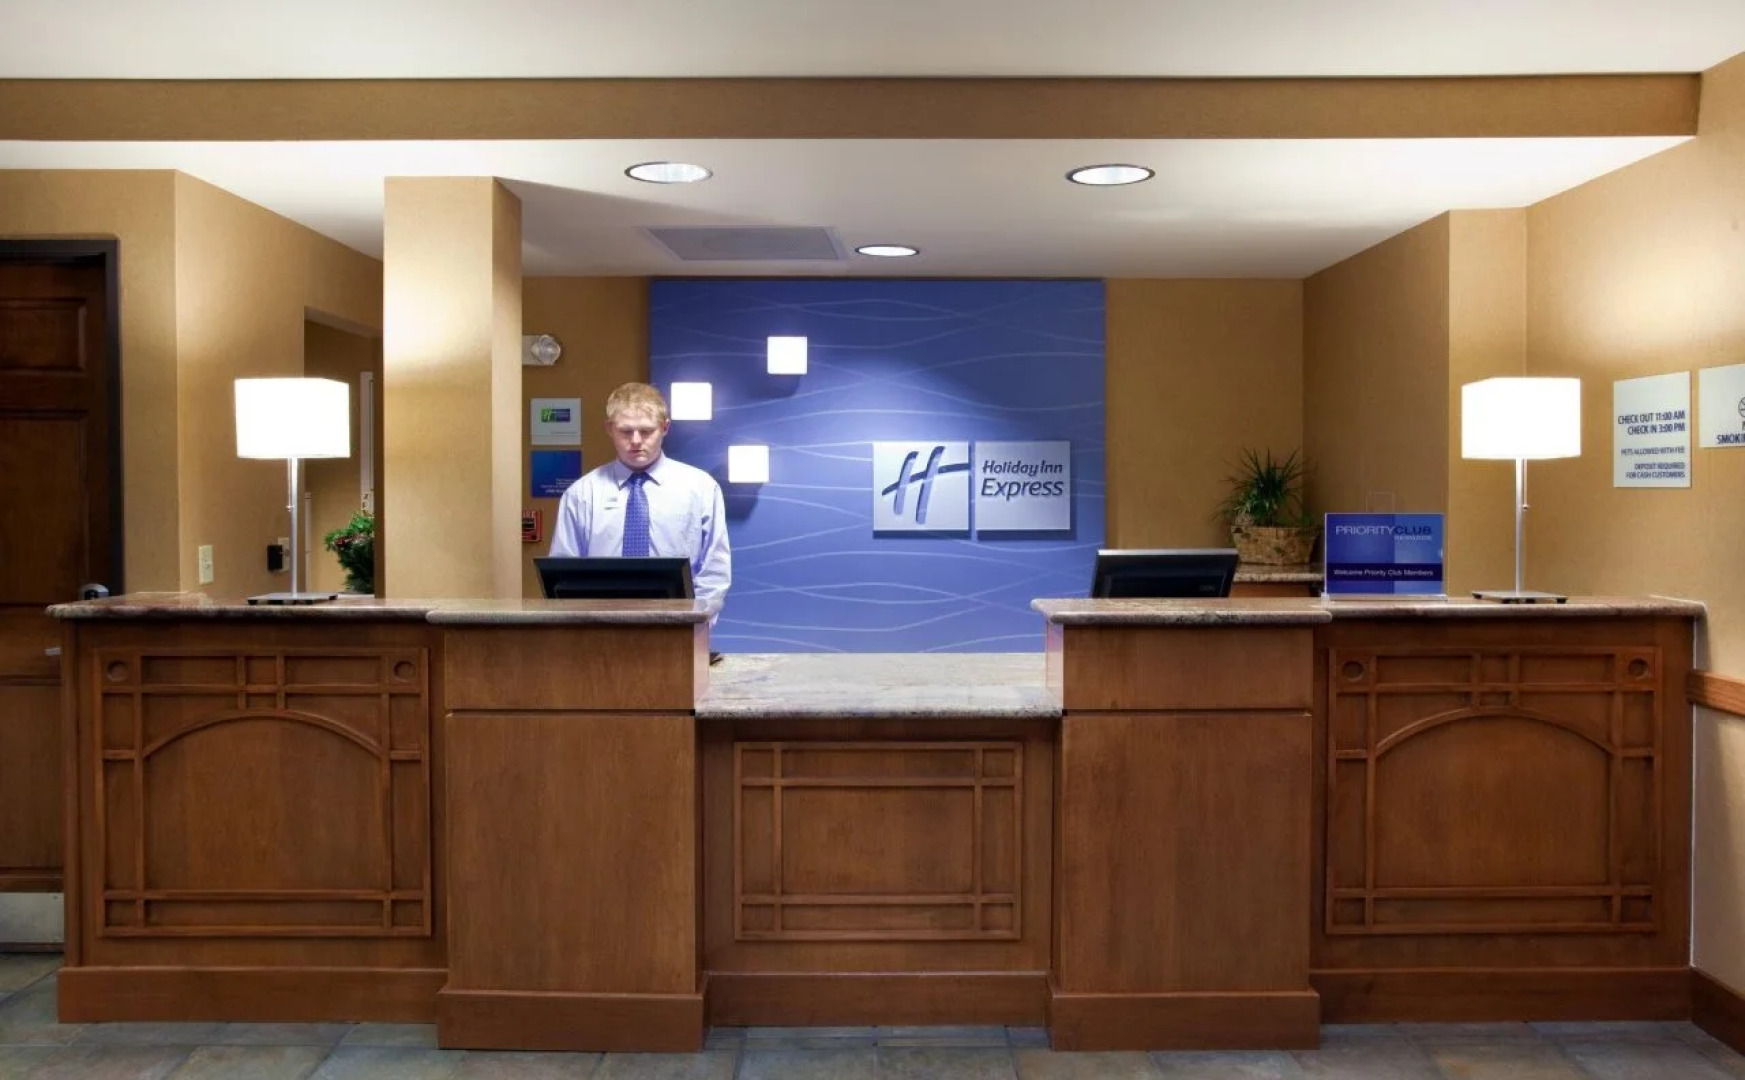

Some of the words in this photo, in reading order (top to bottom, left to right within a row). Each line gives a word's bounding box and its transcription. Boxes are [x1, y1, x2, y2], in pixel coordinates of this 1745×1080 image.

[1618, 414, 1638, 425] CHECK
[1640, 412, 1653, 423] OUT
[1656, 411, 1672, 421] 11:00
[1674, 410, 1685, 420] AM
[1627, 425, 1649, 436] CHECK
[1650, 424, 1657, 434] IN
[1659, 423, 1673, 433] 3:00
[1674, 422, 1685, 432] PM
[1634, 447, 1659, 455] ALLOWED
[1659, 446, 1674, 454] WITH
[1675, 446, 1685, 454] FEE
[982, 460, 1037, 476] Holiday
[1040, 460, 1063, 473] Inn
[1635, 462, 1656, 470] DEPOSIT
[1657, 462, 1685, 470] REQUIRED
[981, 478, 1065, 501] Express
[1364, 569, 1386, 577] Priority
